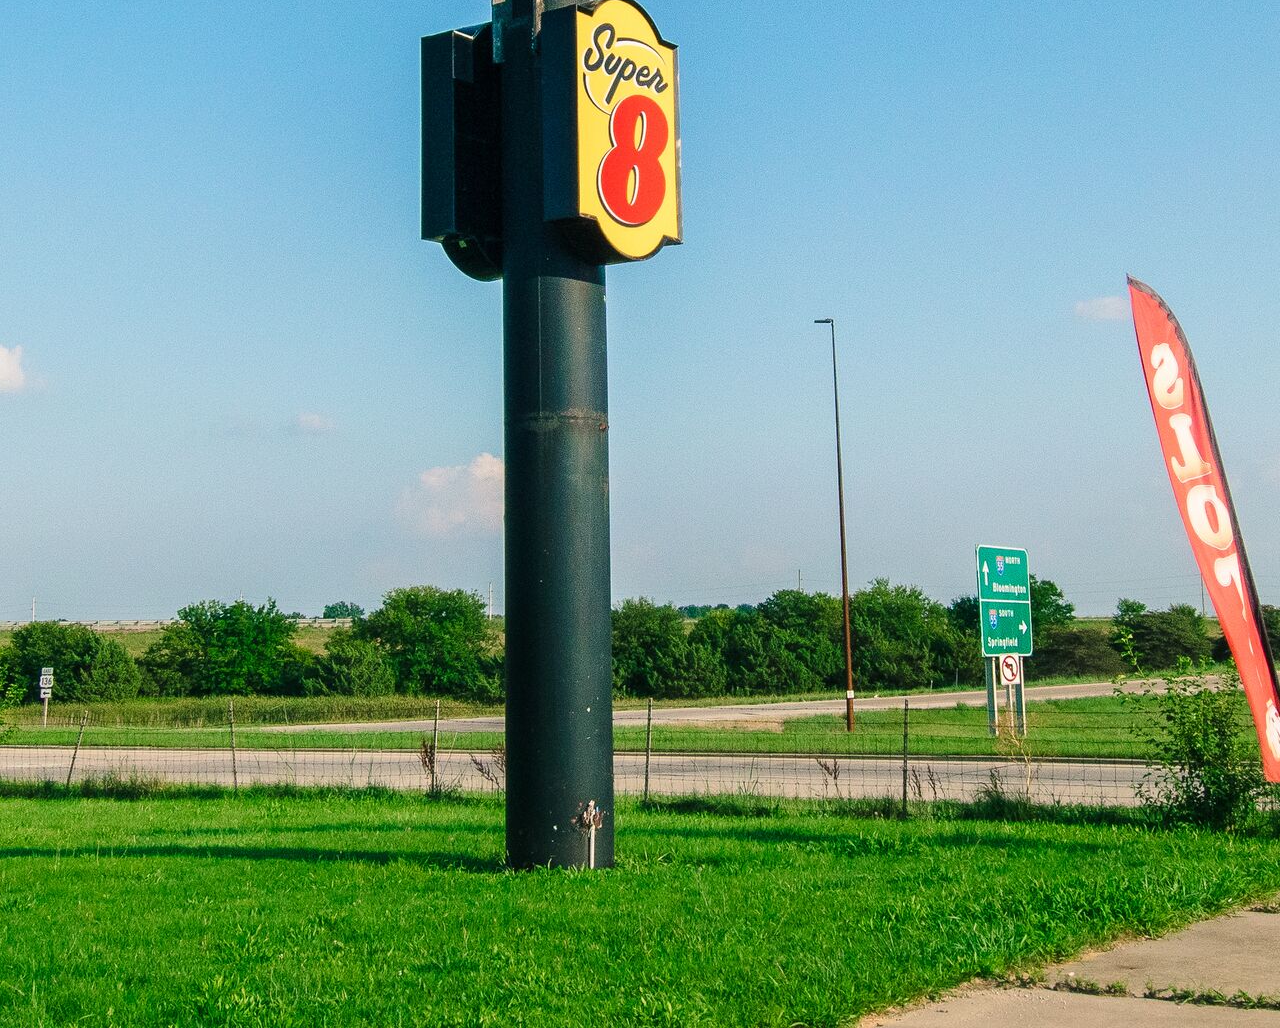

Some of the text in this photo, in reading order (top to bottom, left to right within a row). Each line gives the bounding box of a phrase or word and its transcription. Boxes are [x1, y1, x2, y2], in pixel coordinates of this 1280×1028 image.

[583, 22, 669, 105] Super
[596, 94, 669, 228] 8
[1005, 556, 1021, 565] NORTH
[992, 582, 1026, 596] Bloomington
[998, 609, 1014, 618] SOUTH
[987, 636, 1018, 649] Springfield
[41, 677, 52, 686] 136
